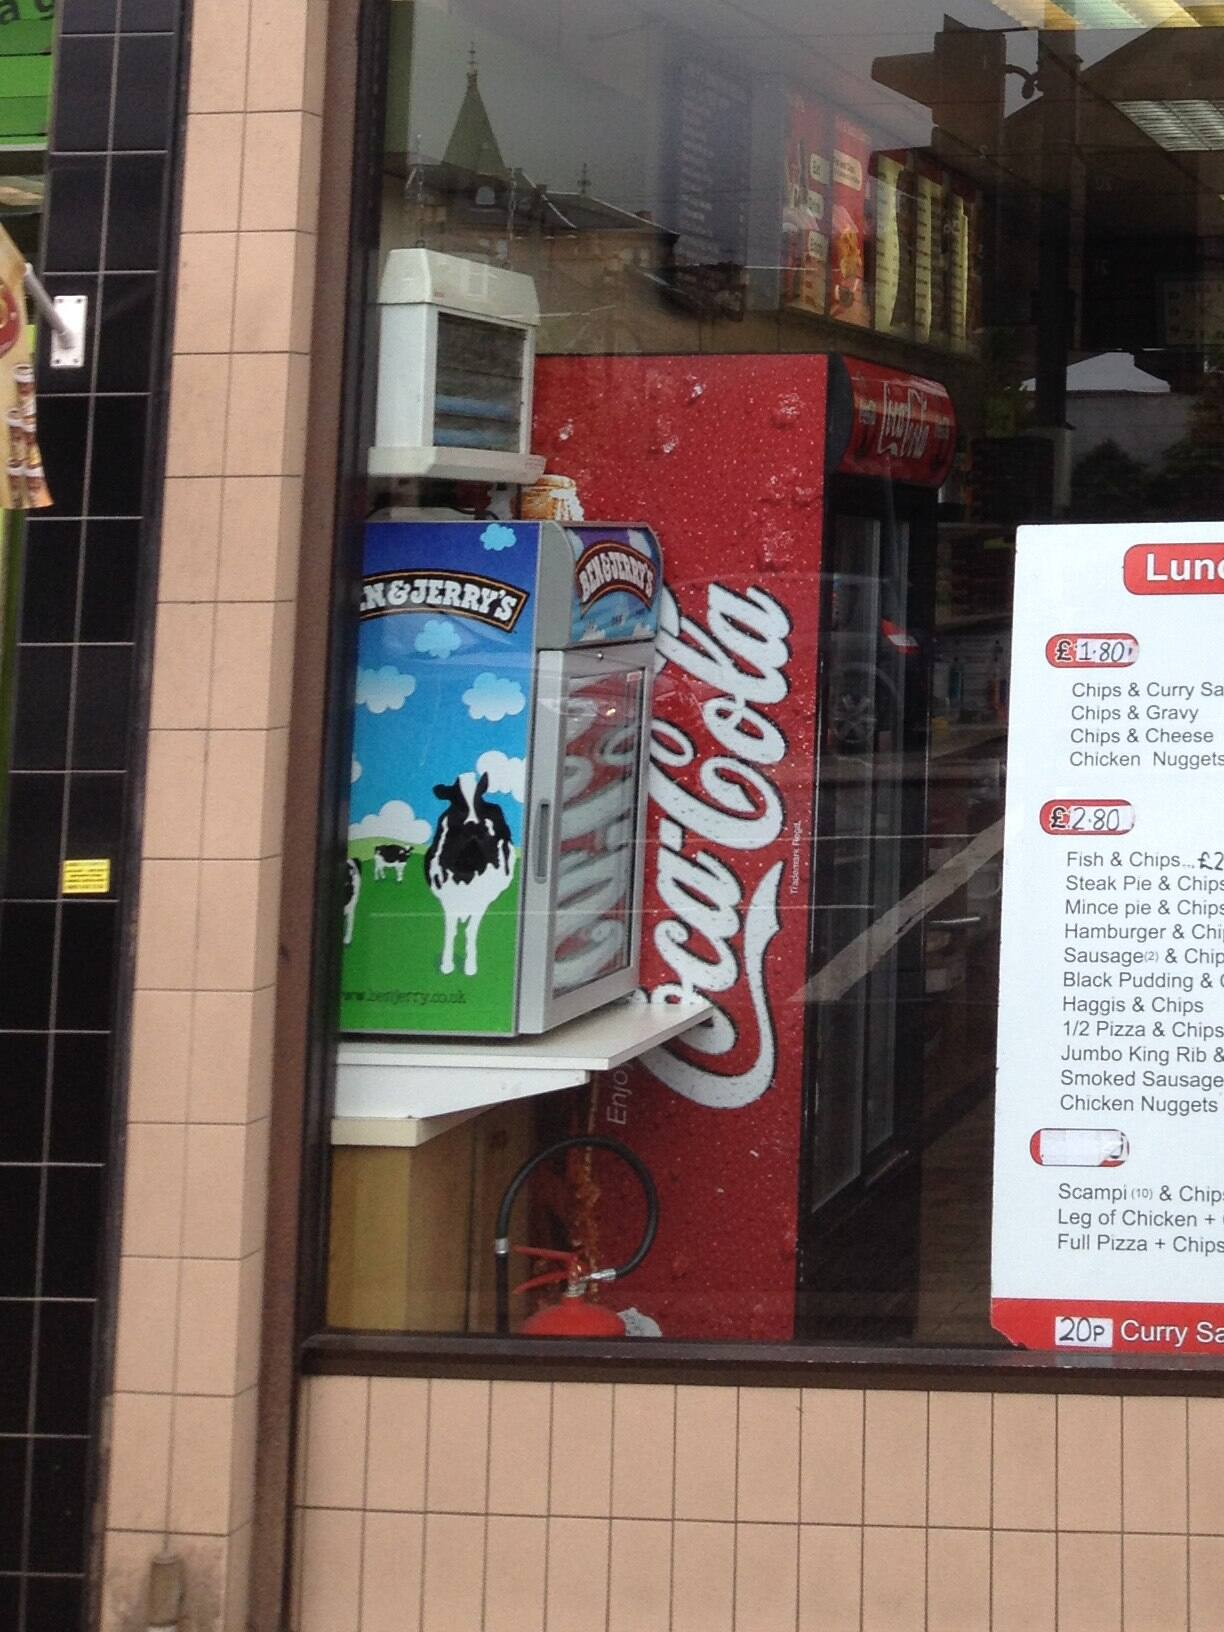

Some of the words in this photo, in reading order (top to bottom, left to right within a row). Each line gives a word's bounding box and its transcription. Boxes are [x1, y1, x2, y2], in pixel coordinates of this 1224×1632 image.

[1072, 682, 1122, 701] Chips
[1128, 682, 1140, 697] &
[1147, 682, 1195, 701] Curry
[1071, 705, 1121, 724] Chips
[1127, 705, 1140, 720] &
[1146, 705, 1199, 724] Gravy
[1071, 728, 1120, 747] Chips
[1126, 728, 1139, 743] &
[1145, 728, 1214, 743] Cheese
[1070, 751, 1140, 767] Chicken
[1067, 851, 1103, 867] Fish
[1110, 851, 1123, 867] &
[1066, 875, 1117, 891] Steak
[1123, 875, 1152, 891] Pie
[1158, 875, 1171, 891] &
[1065, 898, 1118, 915] Mince
[1125, 900, 1152, 919] pie
[1158, 899, 1171, 915] &
[1065, 923, 1166, 943] Hamburger
[1172, 923, 1185, 939] &
[1165, 948, 1178, 964] &
[1064, 971, 1112, 987] Black
[1119, 972, 1194, 992] Pudding
[1200, 972, 1213, 988] &
[1063, 996, 1126, 1016] Haggis
[1132, 996, 1145, 1013] &
[1152, 996, 1204, 1017] Chips
[1064, 1020, 1090, 1037] 1/2
[1096, 1021, 1146, 1037] Pizza
[1152, 1021, 1166, 1037] &
[1172, 1021, 1224, 1042] Chips
[1061, 1044, 1123, 1061] Jumbo
[1129, 1046, 1169, 1066] King
[1177, 1046, 1207, 1063] Rib
[1061, 1069, 1135, 1086] Smoked
[1142, 1070, 1224, 1092] Sausage
[606, 1064, 633, 1125] Enjo
[1060, 1094, 1134, 1111] Chicken
[1141, 1096, 1218, 1117] Nuggets
[1058, 1183, 1127, 1204] Scampi
[1159, 1185, 1172, 1201] &
[1058, 1208, 1092, 1229] Leg
[1098, 1209, 1117, 1226] of
[1122, 1209, 1197, 1227] Chicken
[1204, 1214, 1216, 1225] +
[1058, 1233, 1090, 1250] Full
[1097, 1234, 1147, 1252] Pizza
[1154, 1238, 1166, 1249] +
[1120, 1320, 1188, 1346] Curry
